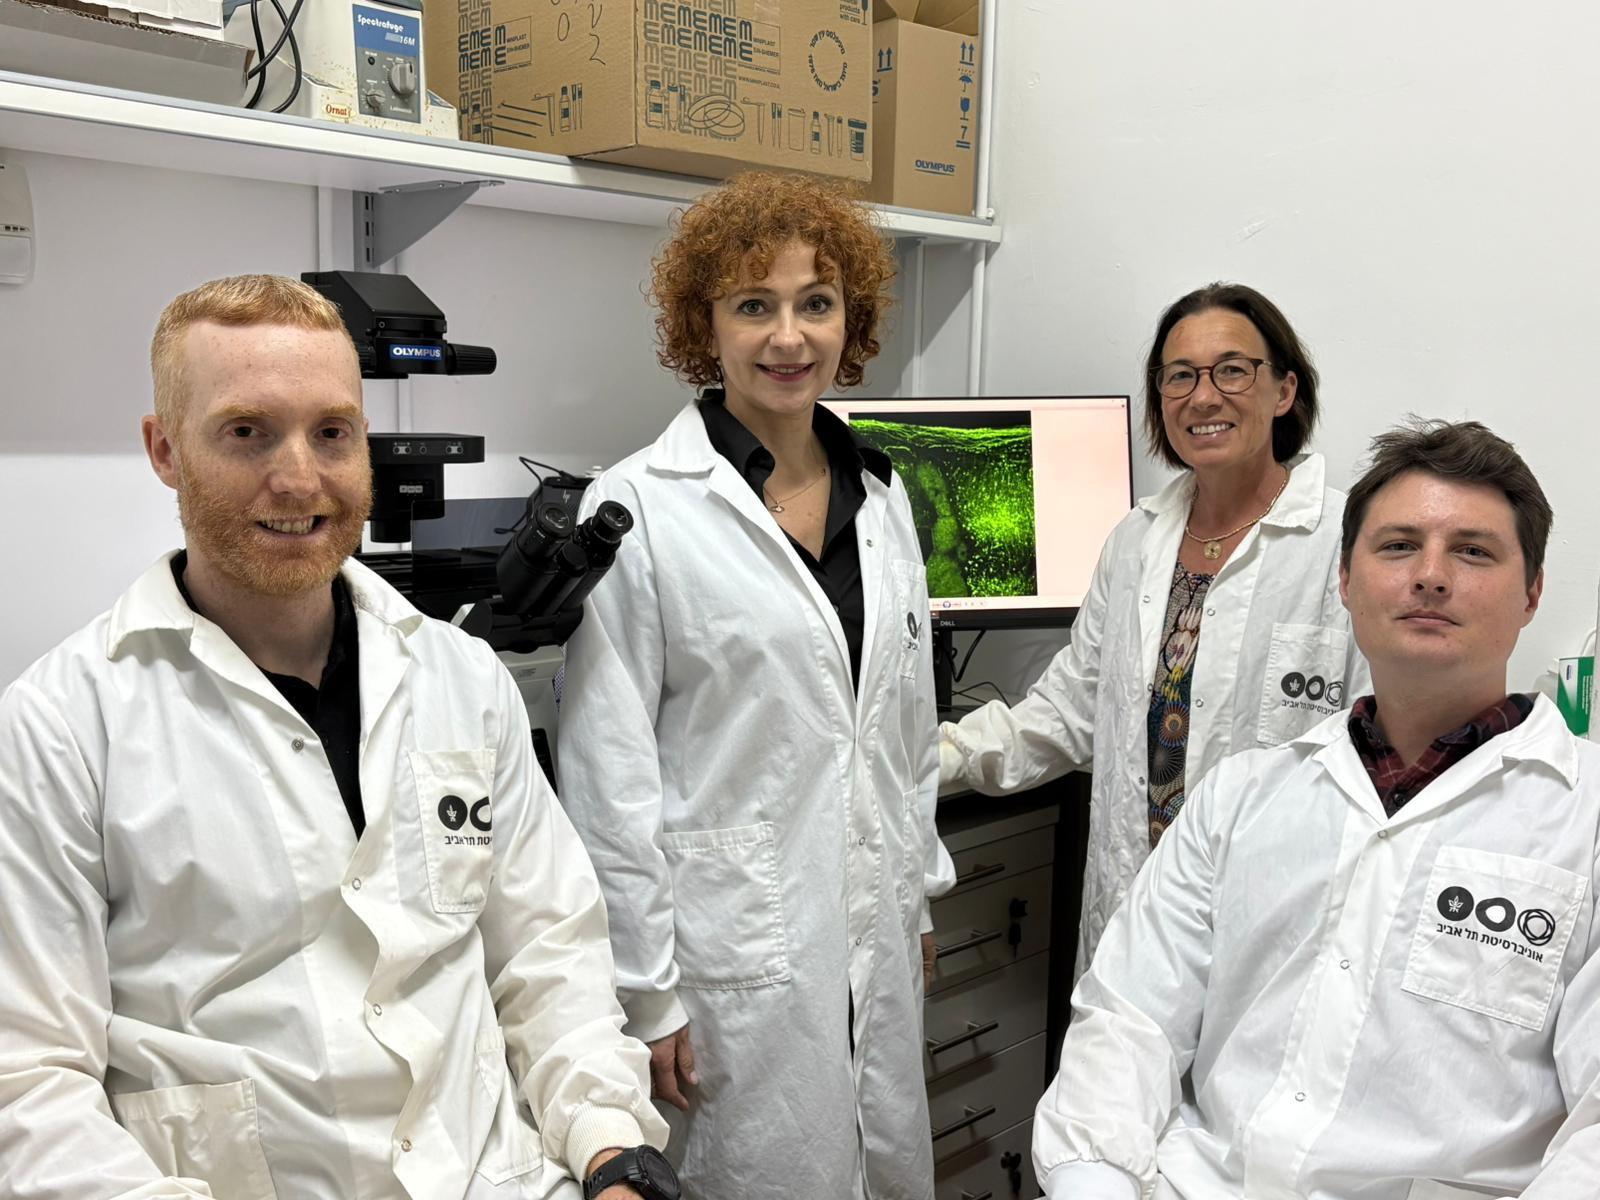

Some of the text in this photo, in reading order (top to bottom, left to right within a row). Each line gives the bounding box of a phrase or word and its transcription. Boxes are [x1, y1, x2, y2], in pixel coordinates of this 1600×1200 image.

[357, 14, 404, 33] Spectrafuge
[400, 36, 415, 46] 16M
[960, 125, 968, 140] 7
[915, 159, 955, 173] OLYMPUS
[393, 346, 441, 358] OLYMPUS
[1436, 923, 1544, 963] אוניברסיטת תל אביב
